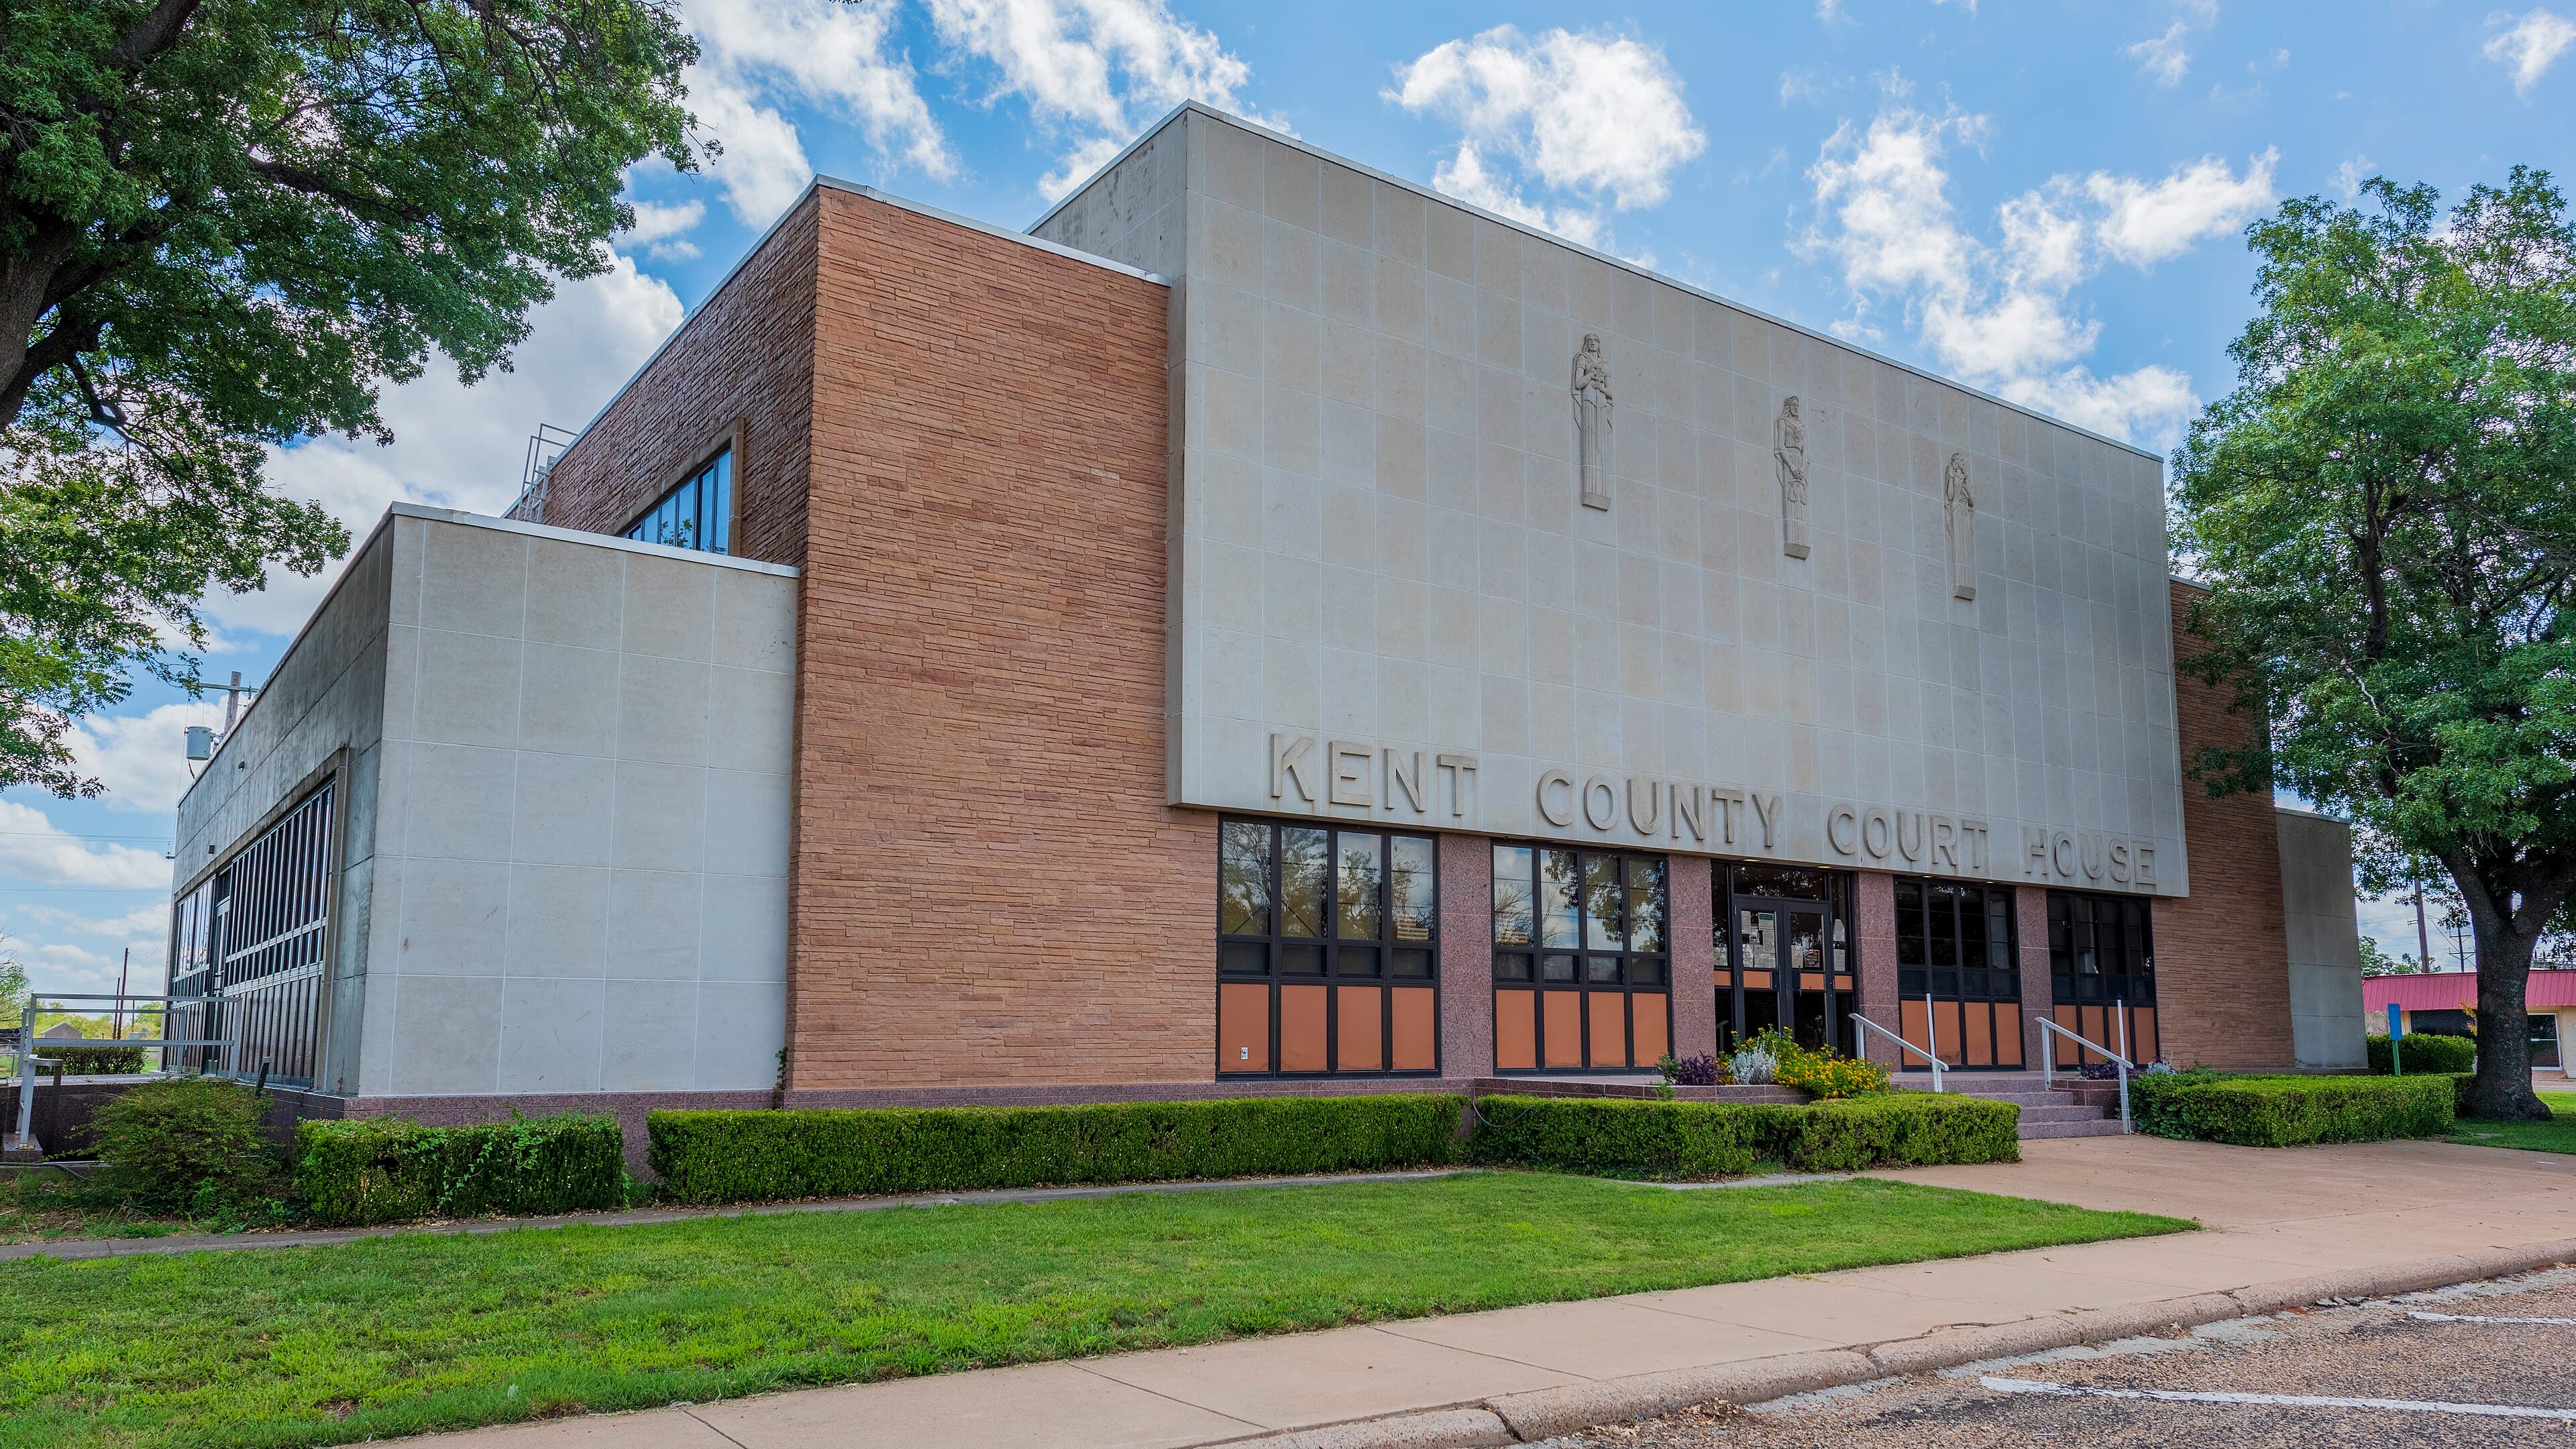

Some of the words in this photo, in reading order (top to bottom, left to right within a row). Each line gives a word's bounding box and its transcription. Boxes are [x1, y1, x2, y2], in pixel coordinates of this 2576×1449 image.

[1271, 733, 1477, 816] KENT
[1537, 769, 1781, 847] COUNTY
[1828, 805, 1988, 867] COURT
[2023, 827, 2157, 885] HOUSE
